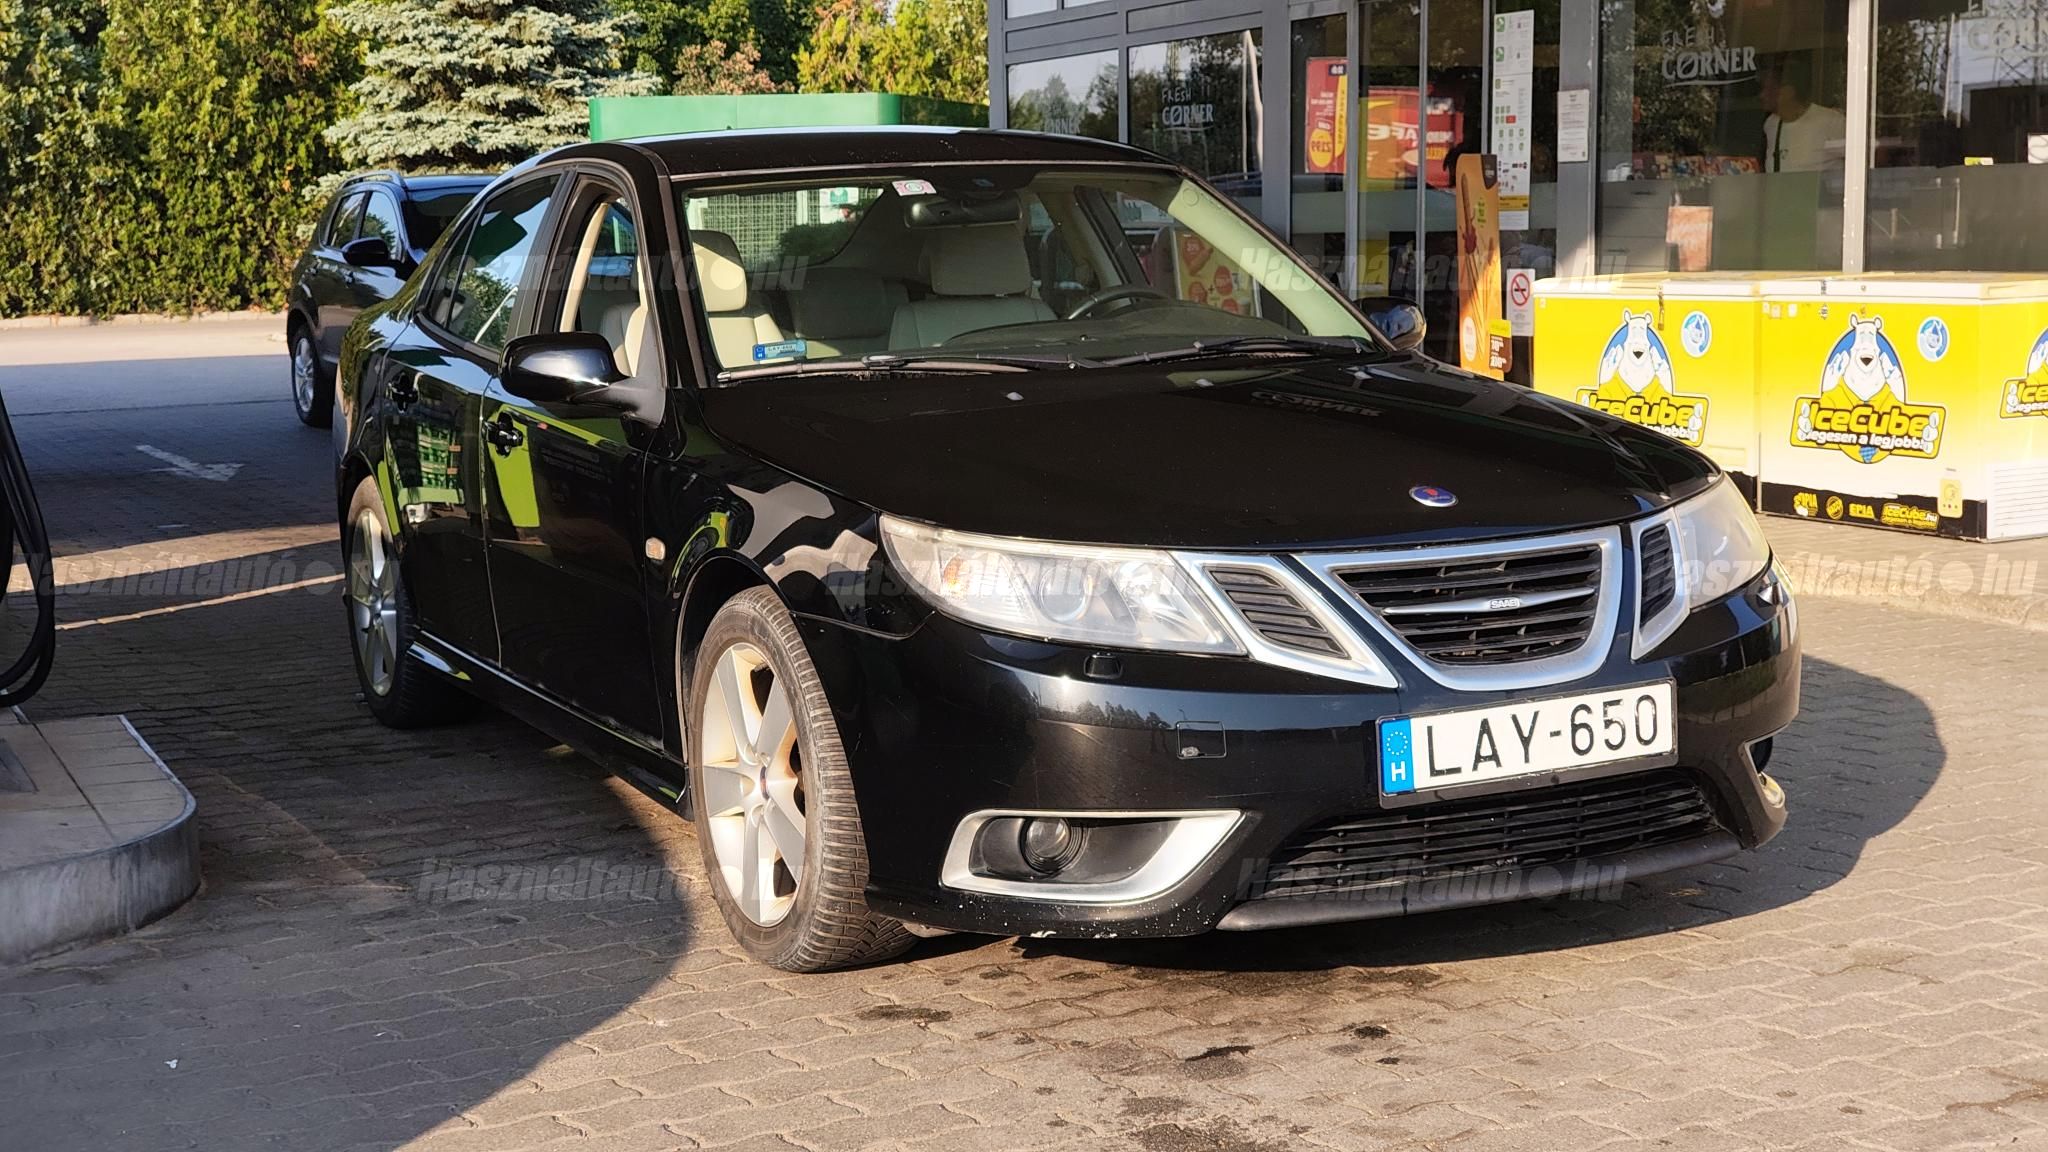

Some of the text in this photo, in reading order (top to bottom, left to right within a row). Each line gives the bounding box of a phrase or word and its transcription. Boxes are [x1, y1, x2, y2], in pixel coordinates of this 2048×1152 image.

[1810, 402, 1929, 438] IceCube
[1491, 599, 1517, 609] SAAB
[1427, 695, 1657, 777] LAY-650
[1391, 762, 1406, 781] H
